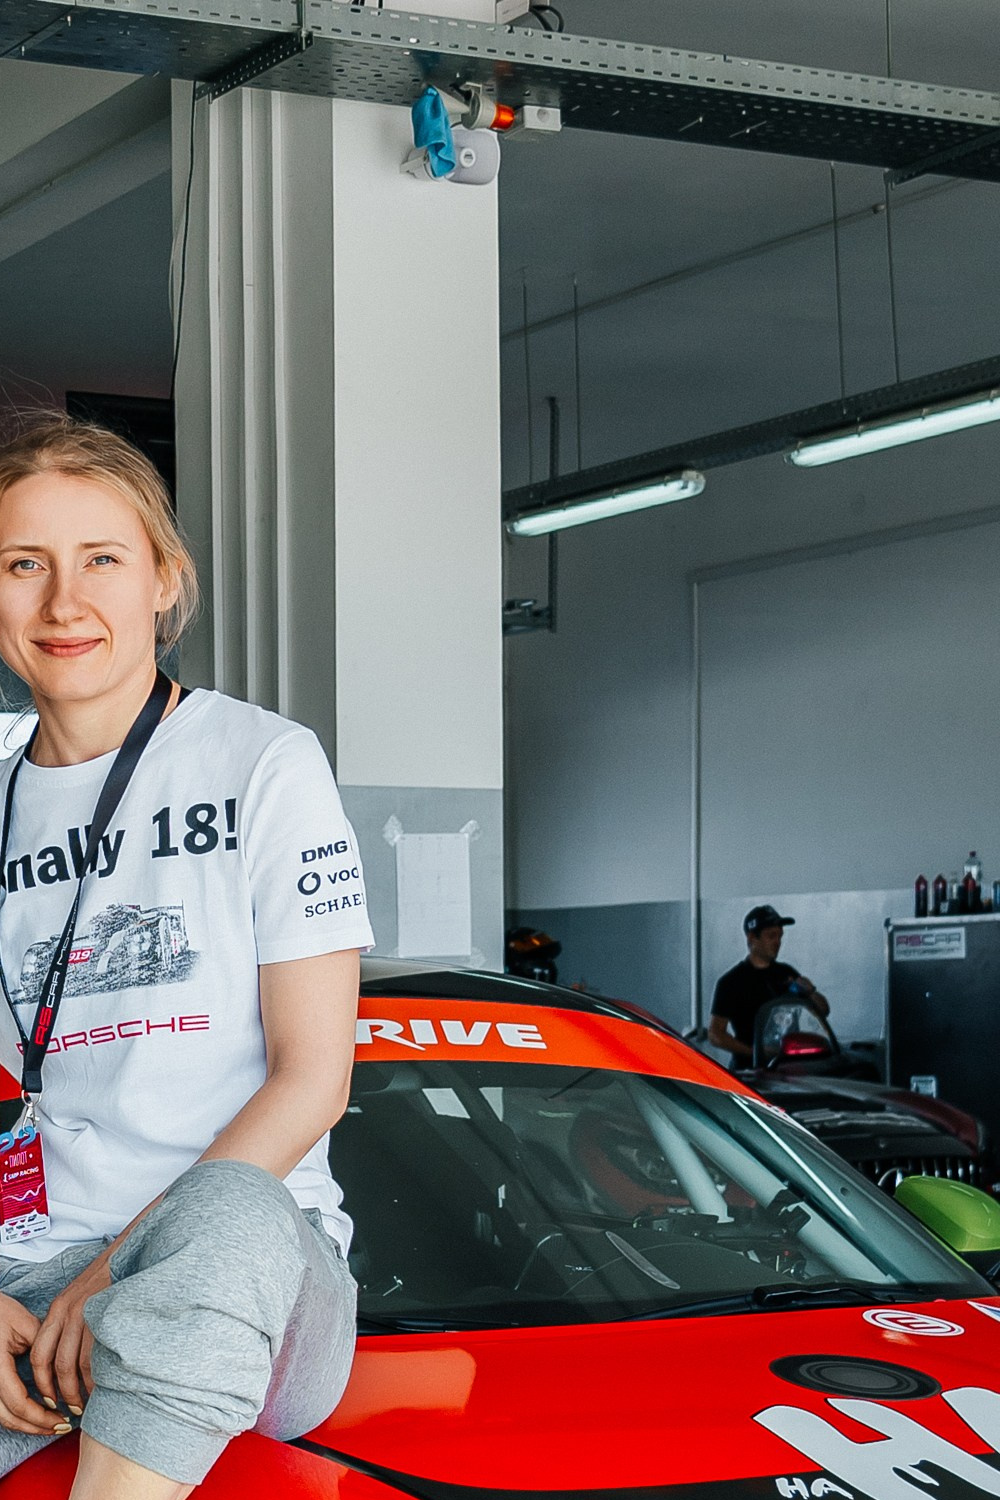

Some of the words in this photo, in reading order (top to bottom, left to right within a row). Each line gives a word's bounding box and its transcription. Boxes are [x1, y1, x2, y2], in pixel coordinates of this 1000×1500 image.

[151, 798, 238, 859] 18!
[301, 840, 348, 864] DMG
[304, 892, 366, 918] SCHAE
[69, 950, 91, 961] 919
[775, 1477, 854, 1500] HA
